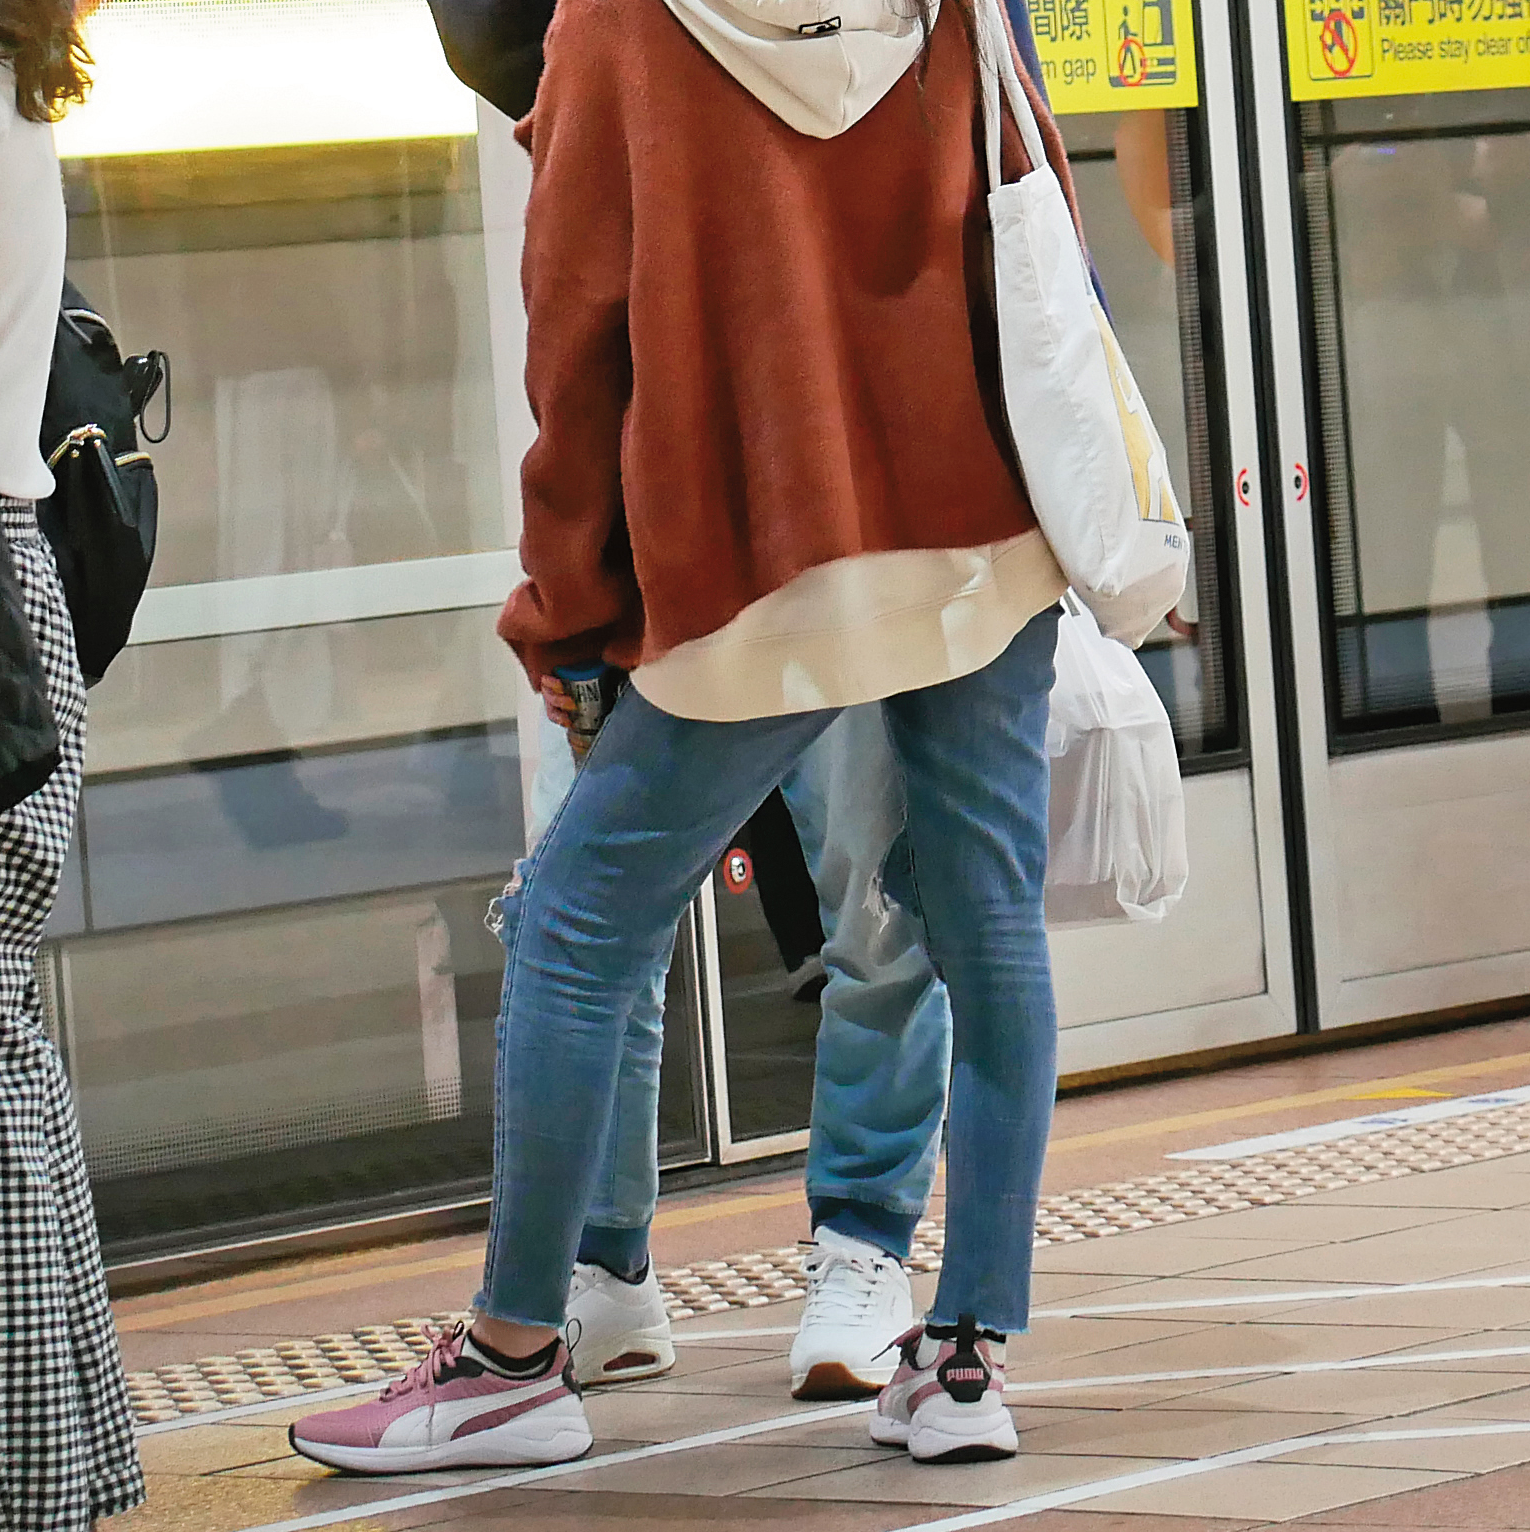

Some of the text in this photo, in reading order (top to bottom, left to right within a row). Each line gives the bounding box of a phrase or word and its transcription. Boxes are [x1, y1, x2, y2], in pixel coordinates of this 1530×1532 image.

[1380, 37, 1435, 62] Please
[1439, 34, 1469, 64] stay
[1476, 31, 1513, 58] clear
[1063, 56, 1097, 86] gap
[946, 1368, 985, 1382] PUMA
